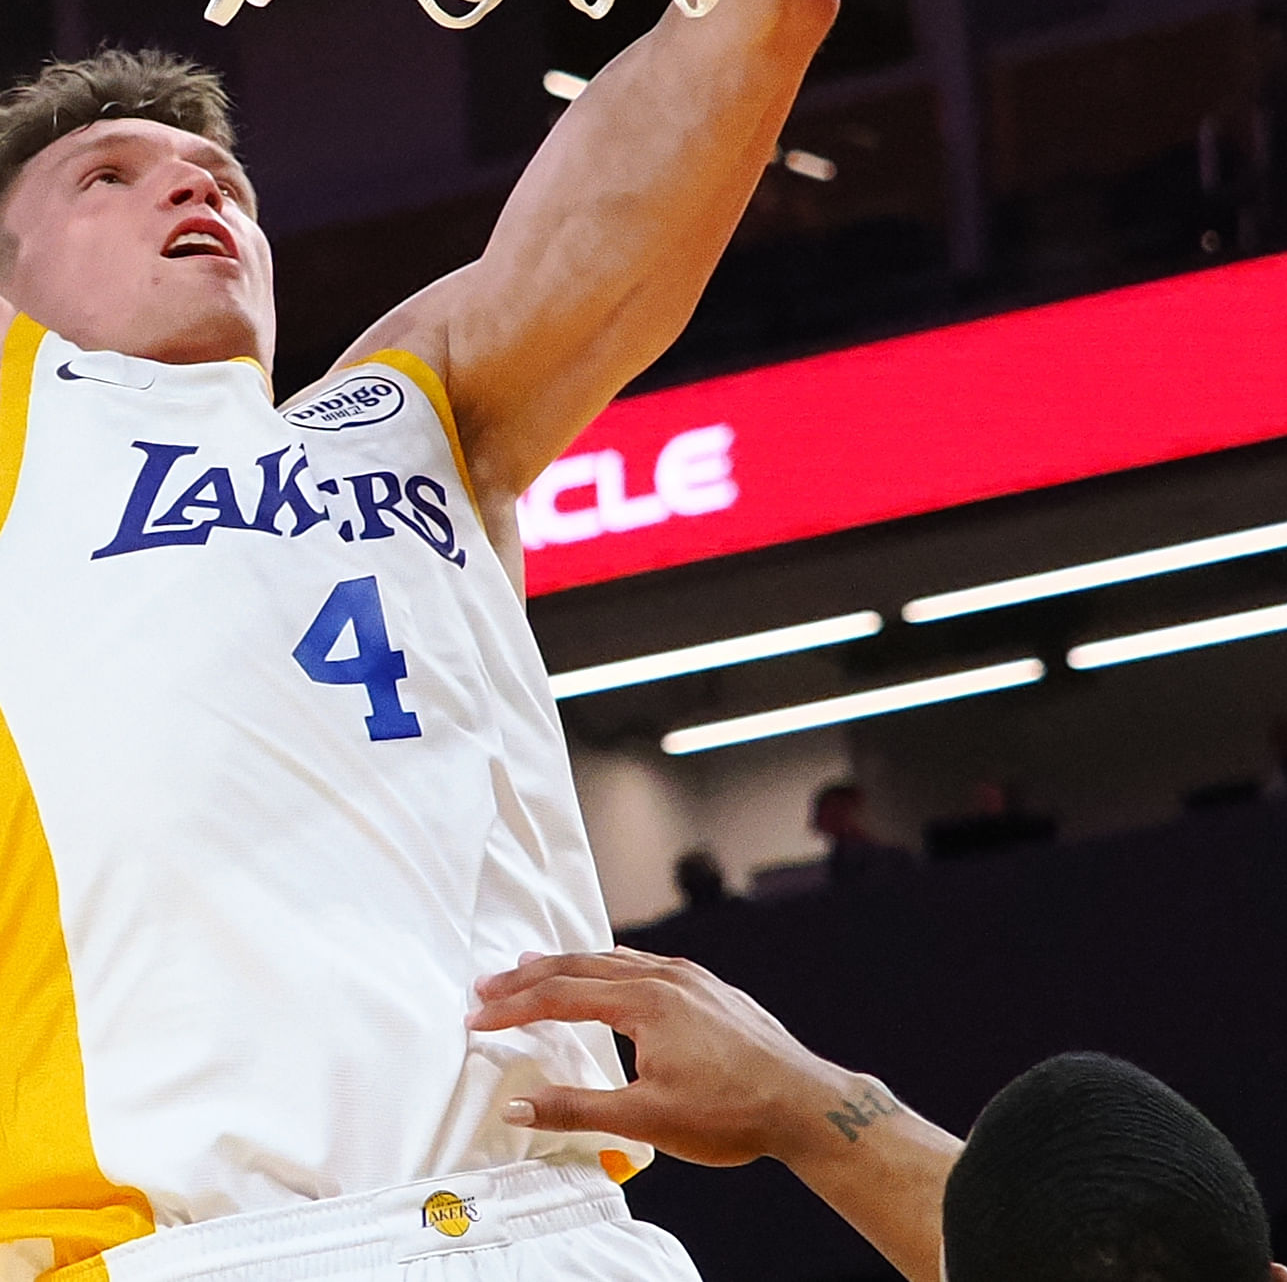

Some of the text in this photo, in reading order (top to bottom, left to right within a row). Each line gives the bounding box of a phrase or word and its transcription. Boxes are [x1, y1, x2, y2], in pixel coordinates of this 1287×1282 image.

[291, 384, 393, 420] bibigo
[291, 575, 423, 742] 4
[421, 1203, 481, 1228] LAKERS
